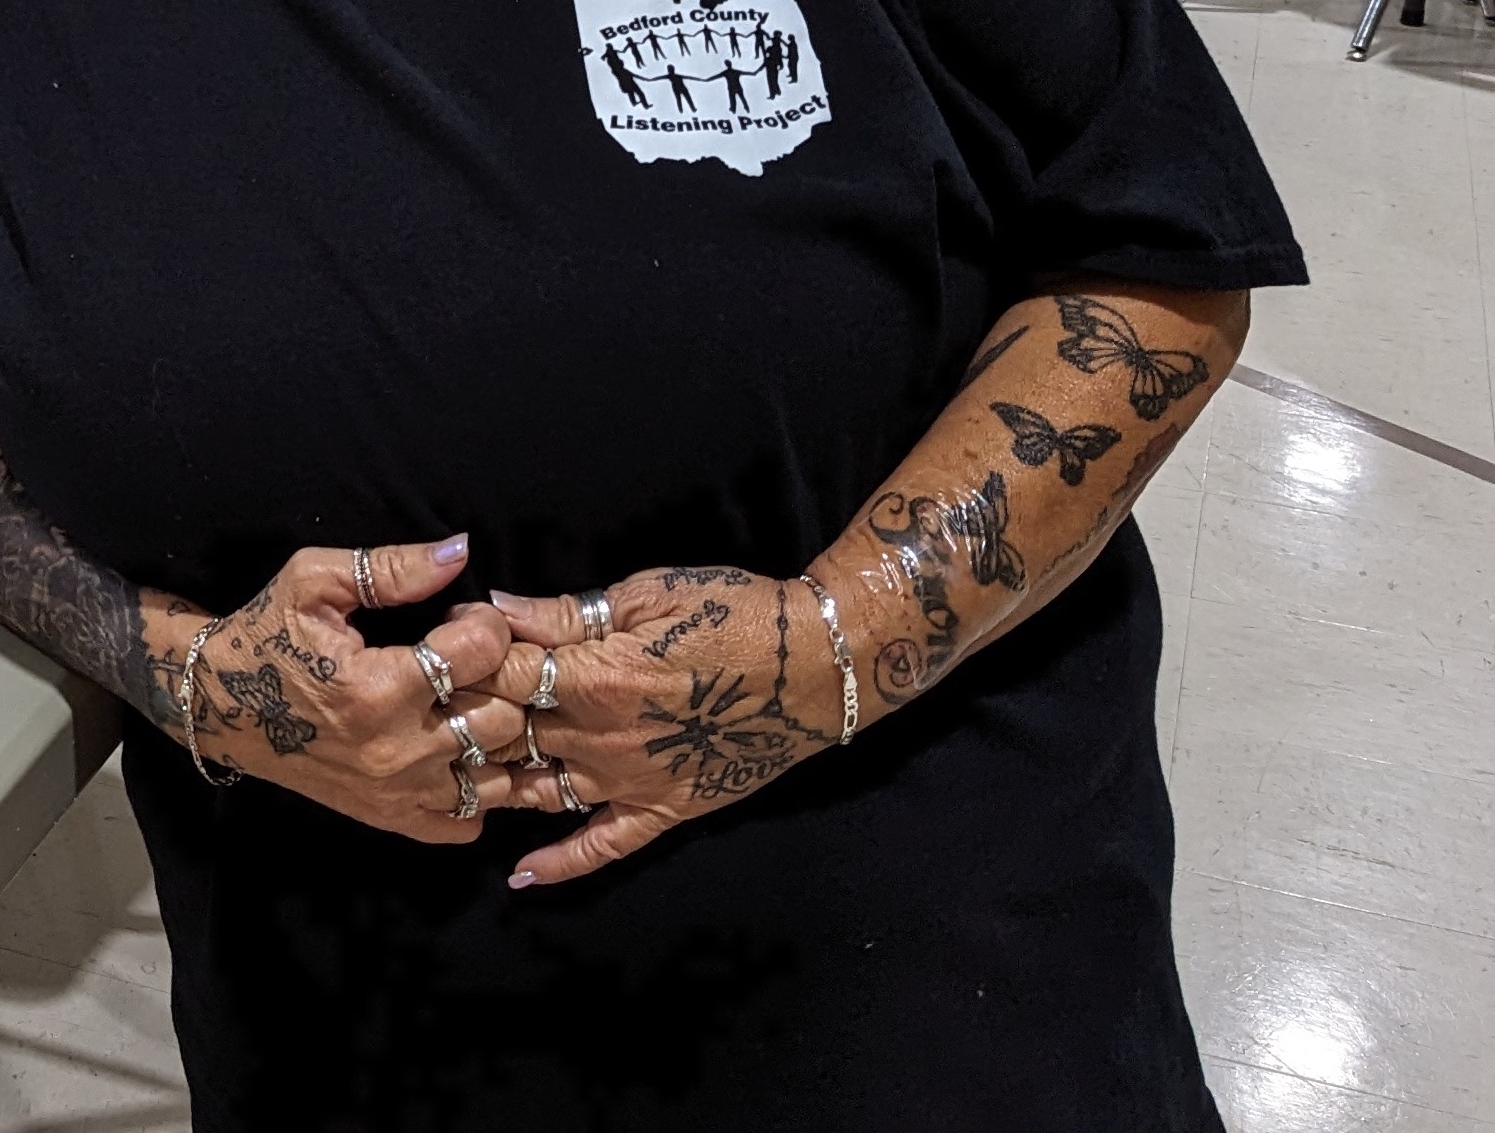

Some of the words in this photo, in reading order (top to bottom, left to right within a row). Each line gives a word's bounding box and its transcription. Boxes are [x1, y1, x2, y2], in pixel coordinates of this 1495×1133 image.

[599, 10, 684, 41] Bedford
[689, 8, 770, 26] County
[610, 114, 733, 134] Listening
[739, 93, 827, 131] Project
